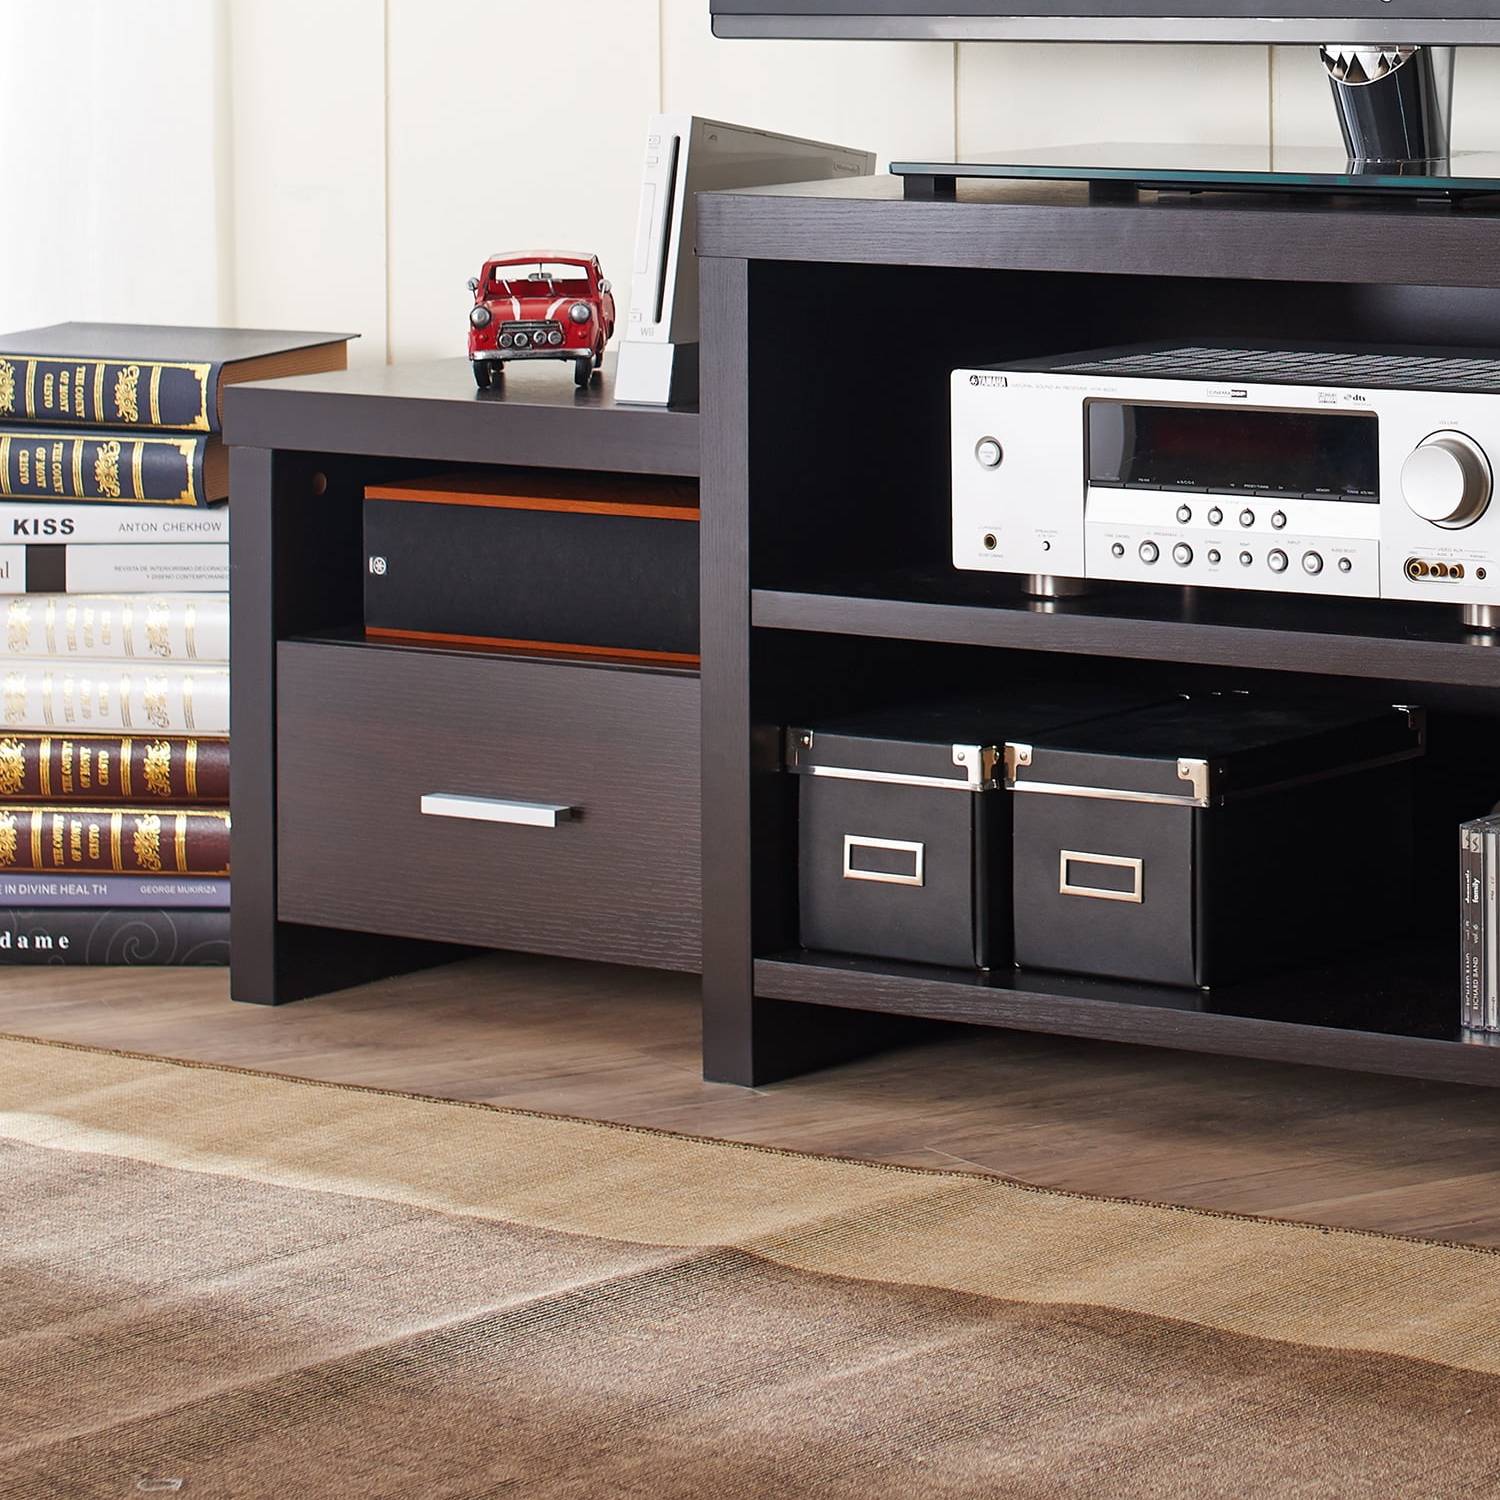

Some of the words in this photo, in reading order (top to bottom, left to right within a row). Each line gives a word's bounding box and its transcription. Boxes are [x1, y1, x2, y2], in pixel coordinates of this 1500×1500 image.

[640, 327, 655, 337] Wii
[60, 371, 69, 384] OF
[75, 365, 86, 386] THE
[43, 373, 53, 408] CRISTO
[60, 385, 69, 412] MONT
[75, 387, 85, 418] COUNT
[35, 447, 46, 460] OF
[53, 442, 64, 462] THE
[19, 449, 29, 485] CRISTO
[35, 461, 46, 488] MONT
[52, 463, 64, 493] COUNT
[13, 518, 75, 535] KISS
[118, 522, 158, 532] ANTON
[163, 521, 222, 532] CHEKHOW
[62, 741, 73, 774] COUNT
[53, 813, 64, 847] COUNT
[4, 884, 17, 895] IN
[18, 884, 58, 896] DIVINE
[140, 885, 175, 894] GEORGE
[1471, 877, 1481, 903] family
[0, 930, 70, 949] dame
